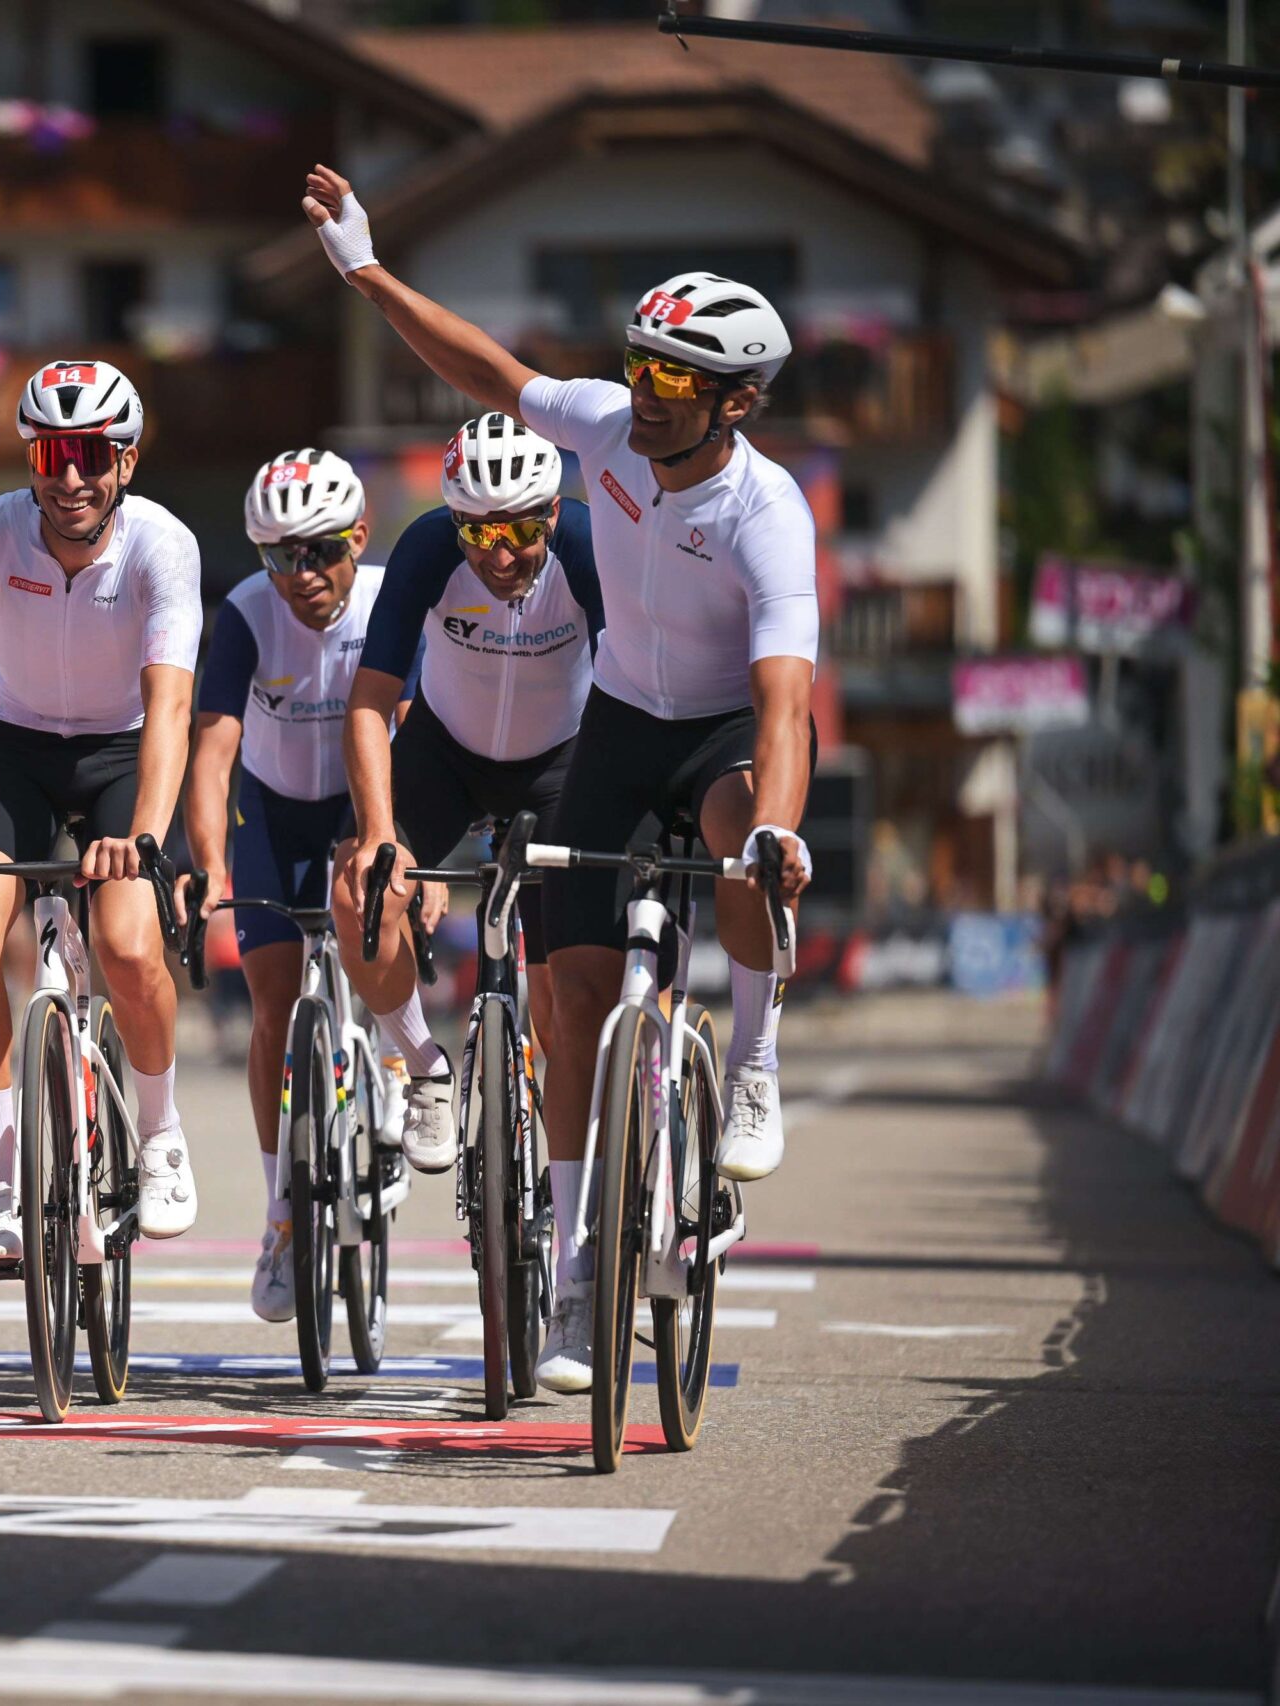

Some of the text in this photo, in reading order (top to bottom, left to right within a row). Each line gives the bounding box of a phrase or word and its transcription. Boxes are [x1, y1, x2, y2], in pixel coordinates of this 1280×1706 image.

[650, 298, 676, 321] 13
[56, 369, 81, 383] 14
[271, 465, 297, 482] 69
[443, 616, 576, 647] EY Parthenon
[482, 647, 508, 656] futur
[290, 697, 346, 716] Parth
